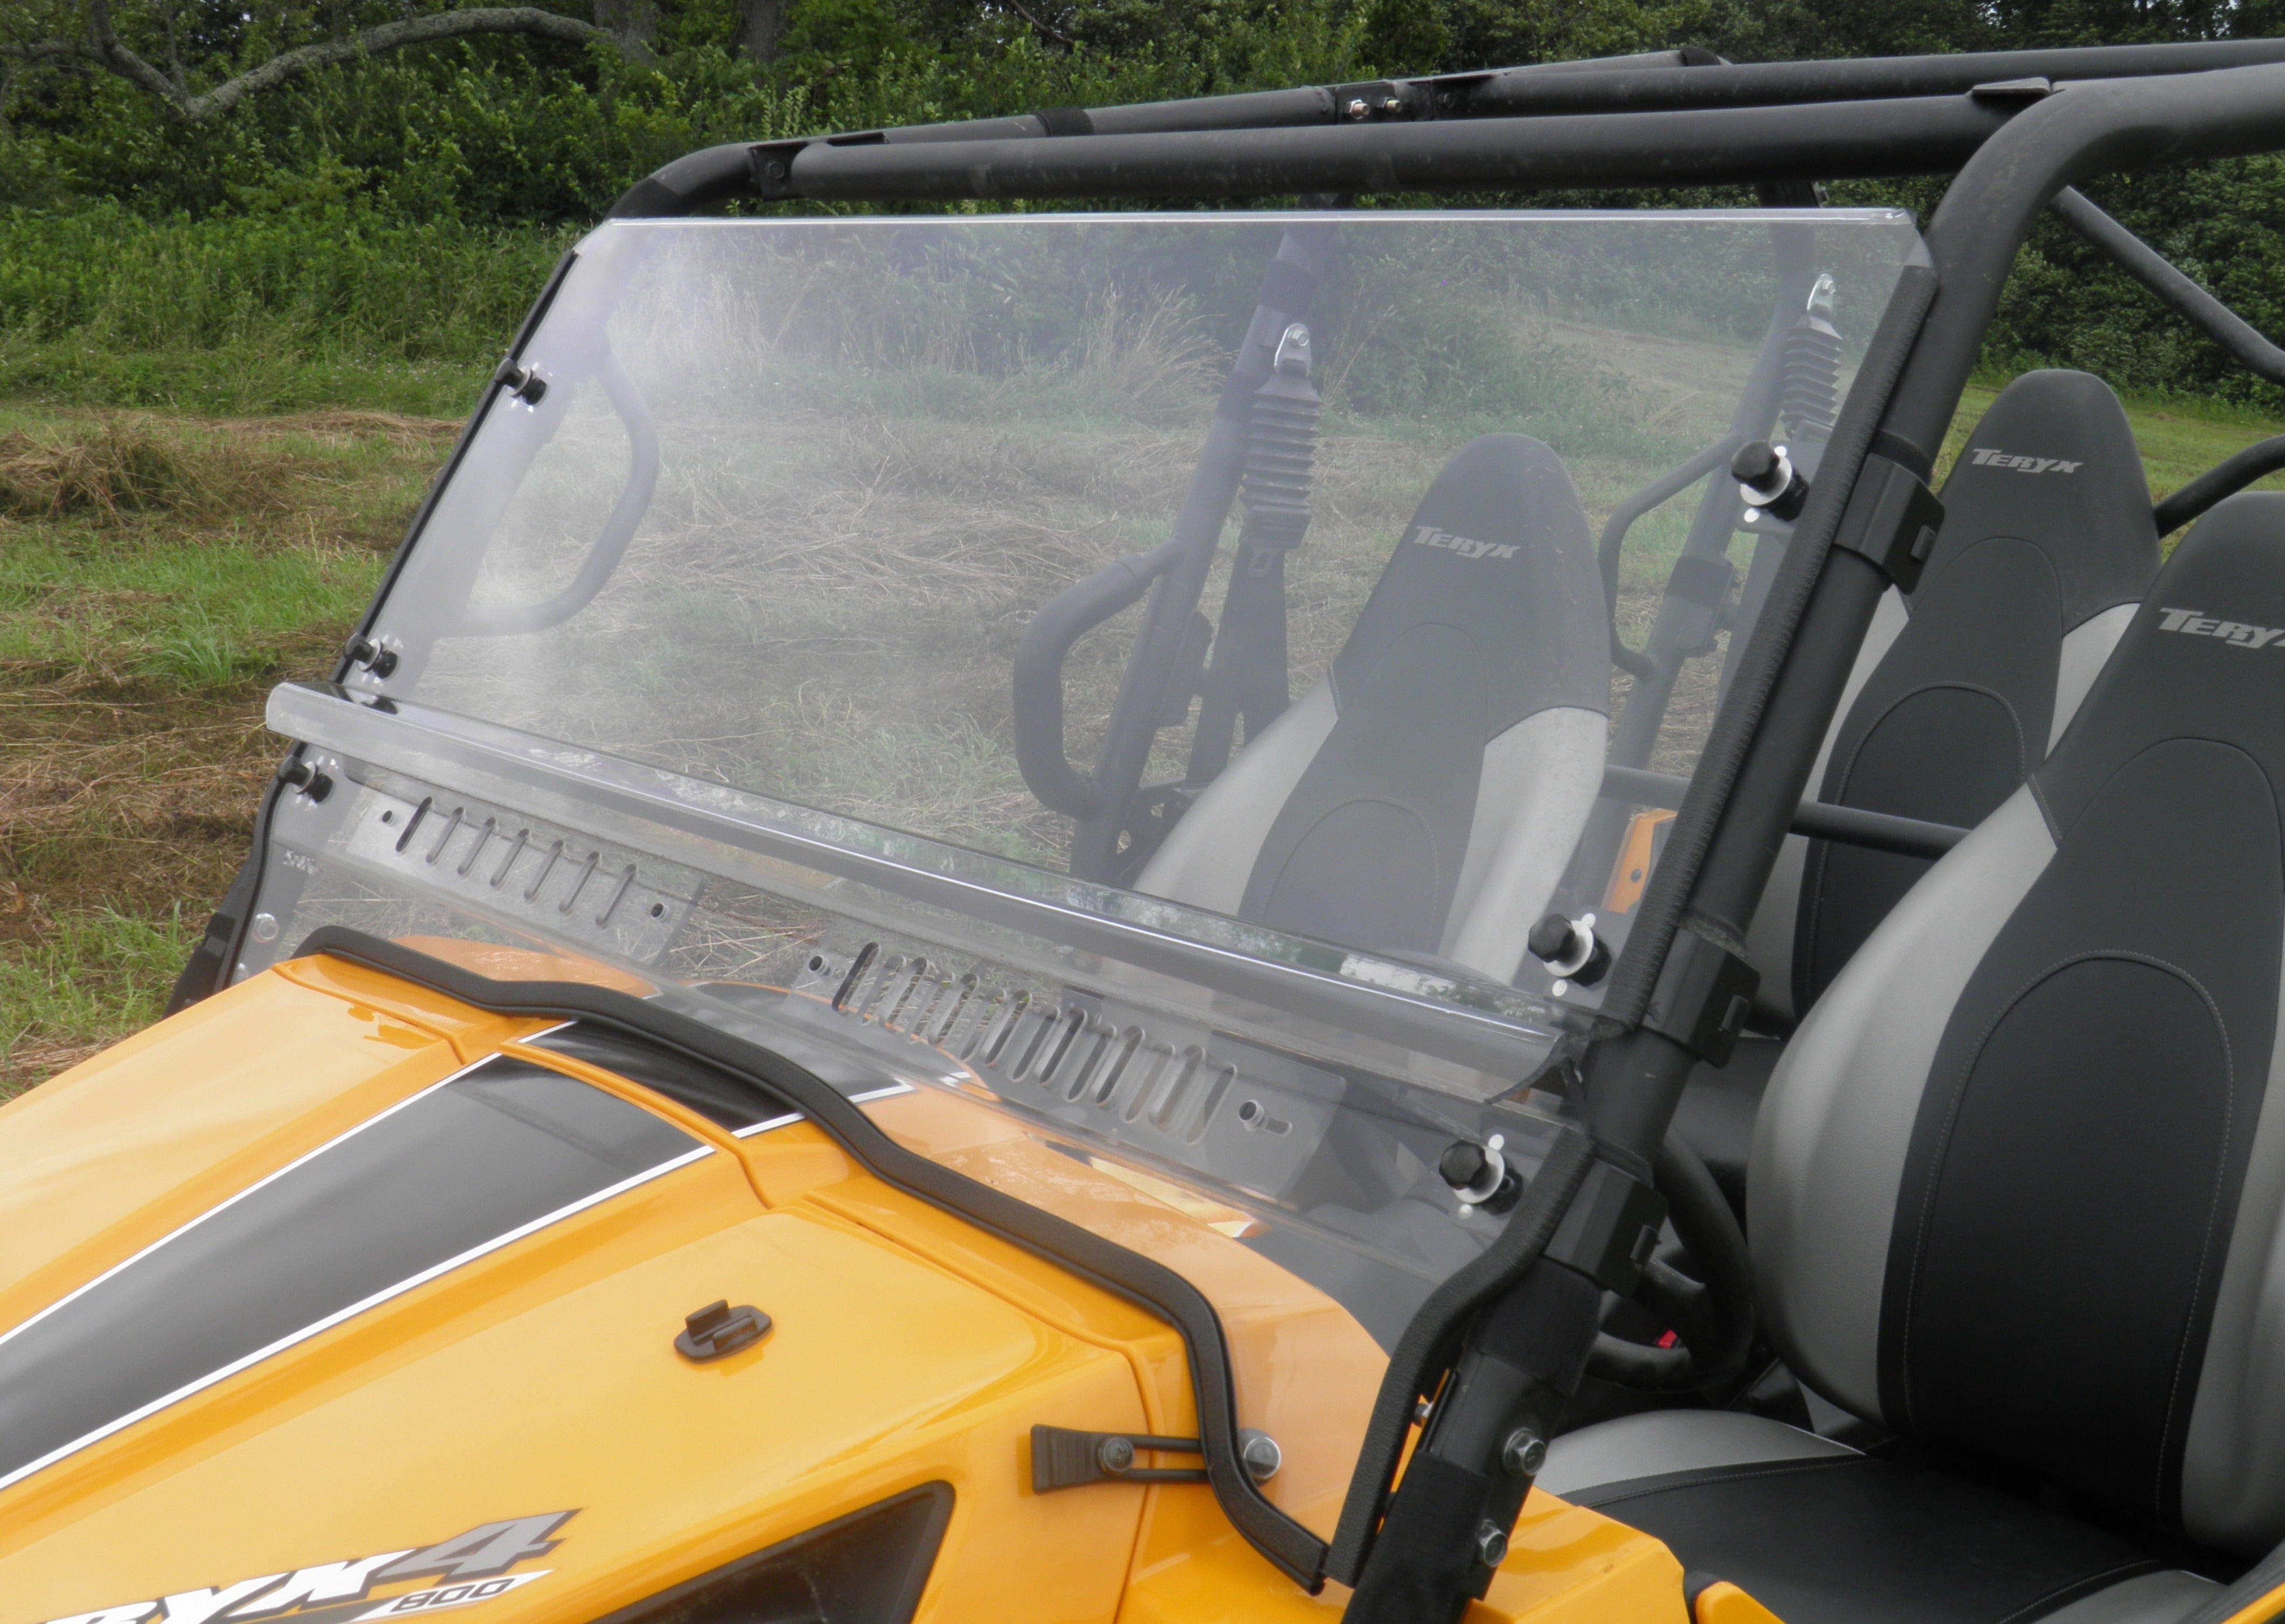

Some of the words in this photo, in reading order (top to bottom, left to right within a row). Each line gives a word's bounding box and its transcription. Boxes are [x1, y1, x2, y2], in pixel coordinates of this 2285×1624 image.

[1971, 448, 2083, 473] TERYX
[1414, 525, 1521, 559] TERYX
[2158, 607, 2285, 648] TERY
[391, 1578, 515, 1612] 800
